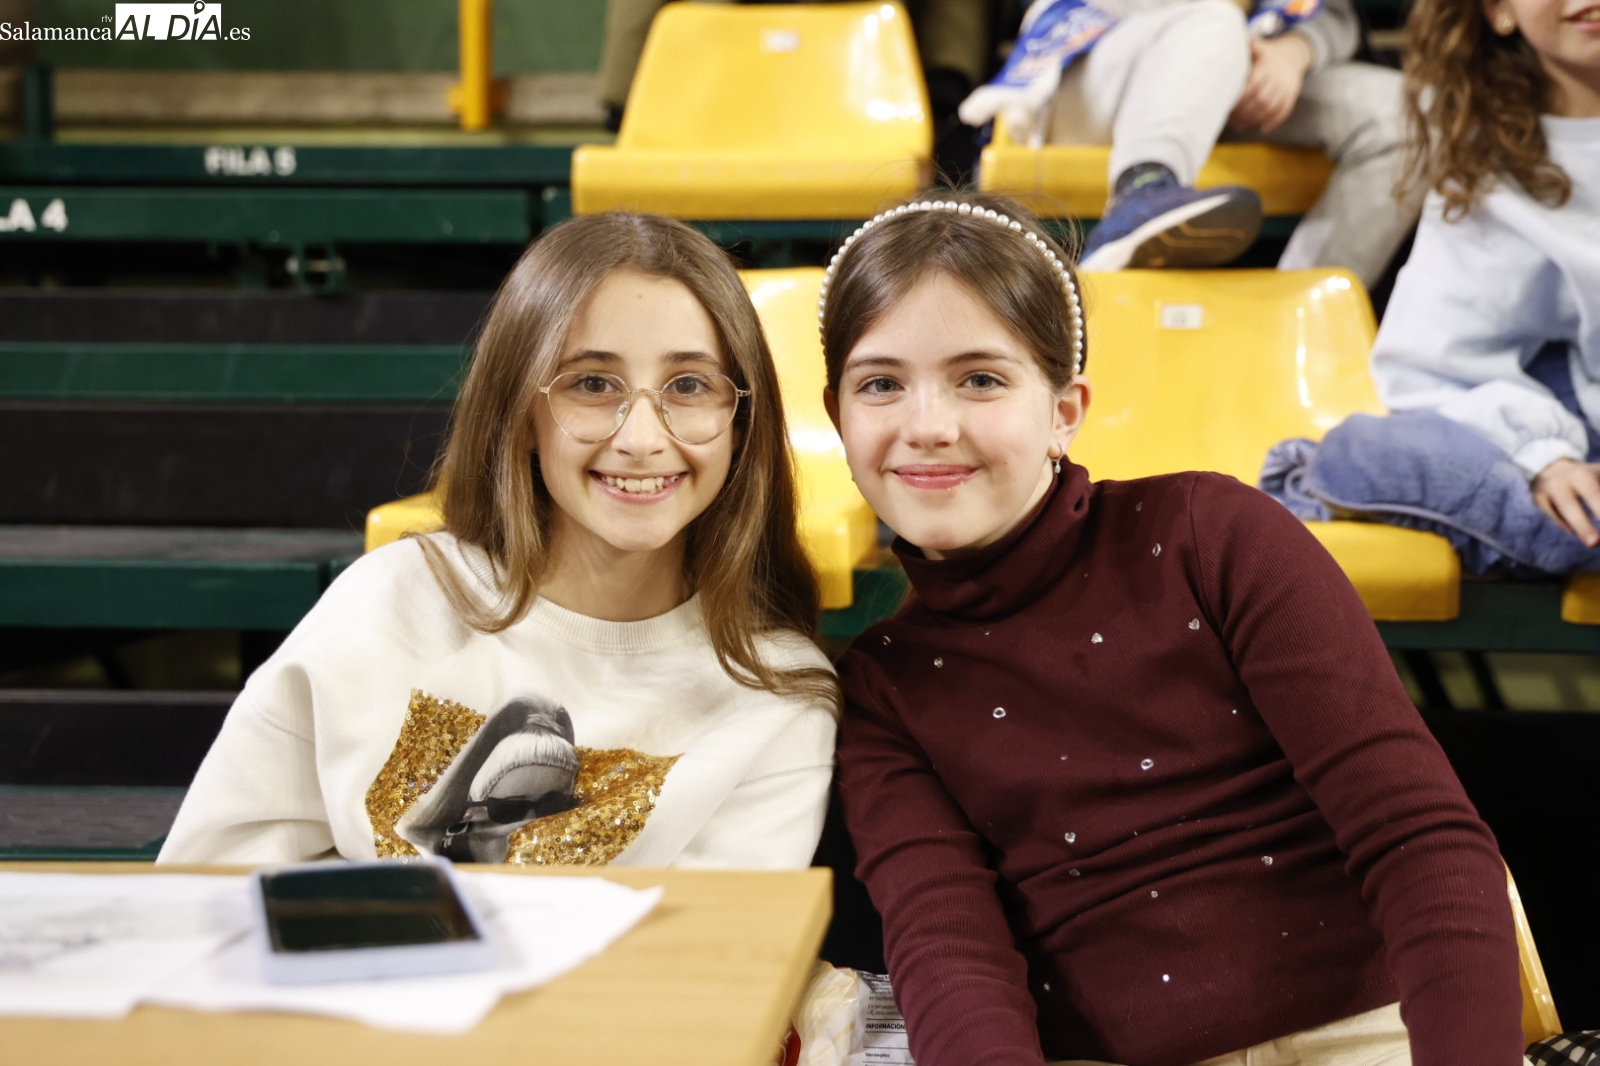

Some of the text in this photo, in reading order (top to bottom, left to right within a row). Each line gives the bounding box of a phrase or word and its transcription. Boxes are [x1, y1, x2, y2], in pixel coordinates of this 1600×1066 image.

[204, 146, 273, 177] FILA
[40, 198, 69, 233] 4
[865, 1022, 906, 1030] INFORMACIÓN
